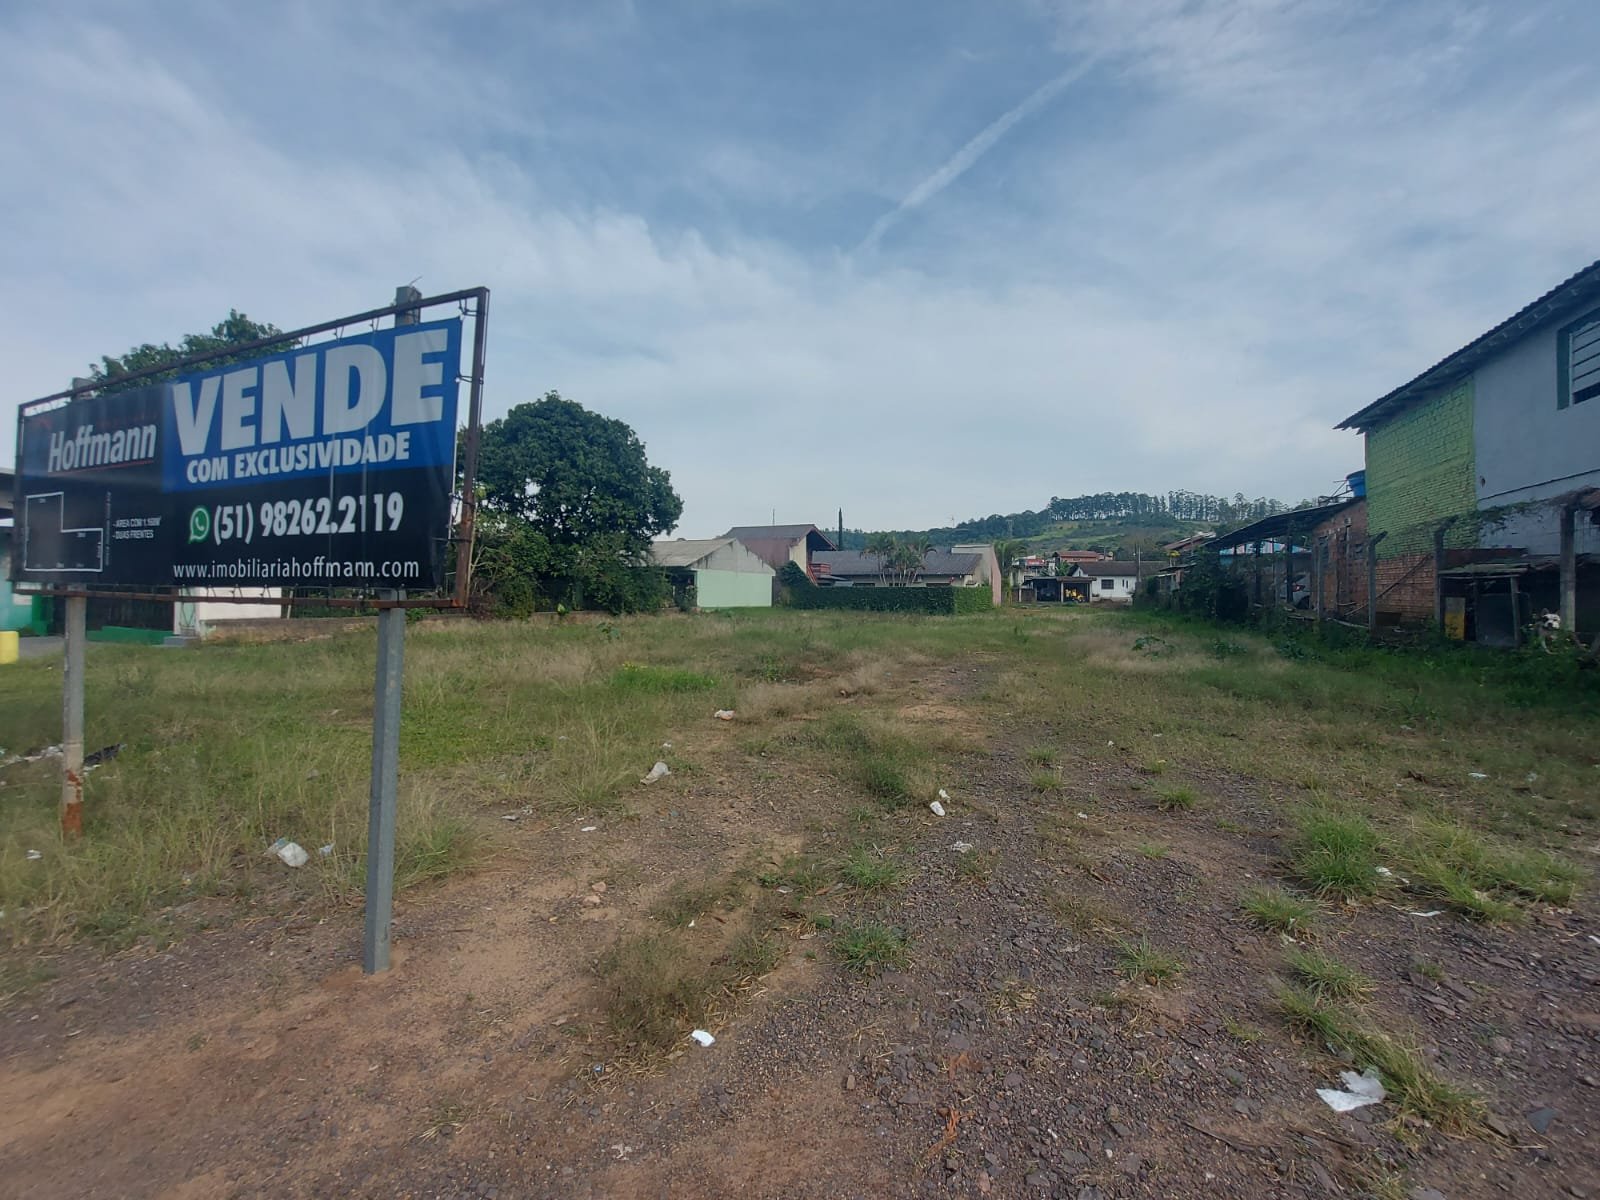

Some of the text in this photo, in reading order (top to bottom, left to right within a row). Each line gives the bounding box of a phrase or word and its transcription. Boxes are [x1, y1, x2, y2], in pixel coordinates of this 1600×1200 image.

[172, 328, 448, 456] VENDE
[48, 424, 157, 473] Hoffmann
[187, 431, 410, 484] COM EXCLUSIVIDADE
[214, 492, 404, 545] (51) 98262.2119
[173, 556, 420, 578] www.imobiliariahoffmann.com
